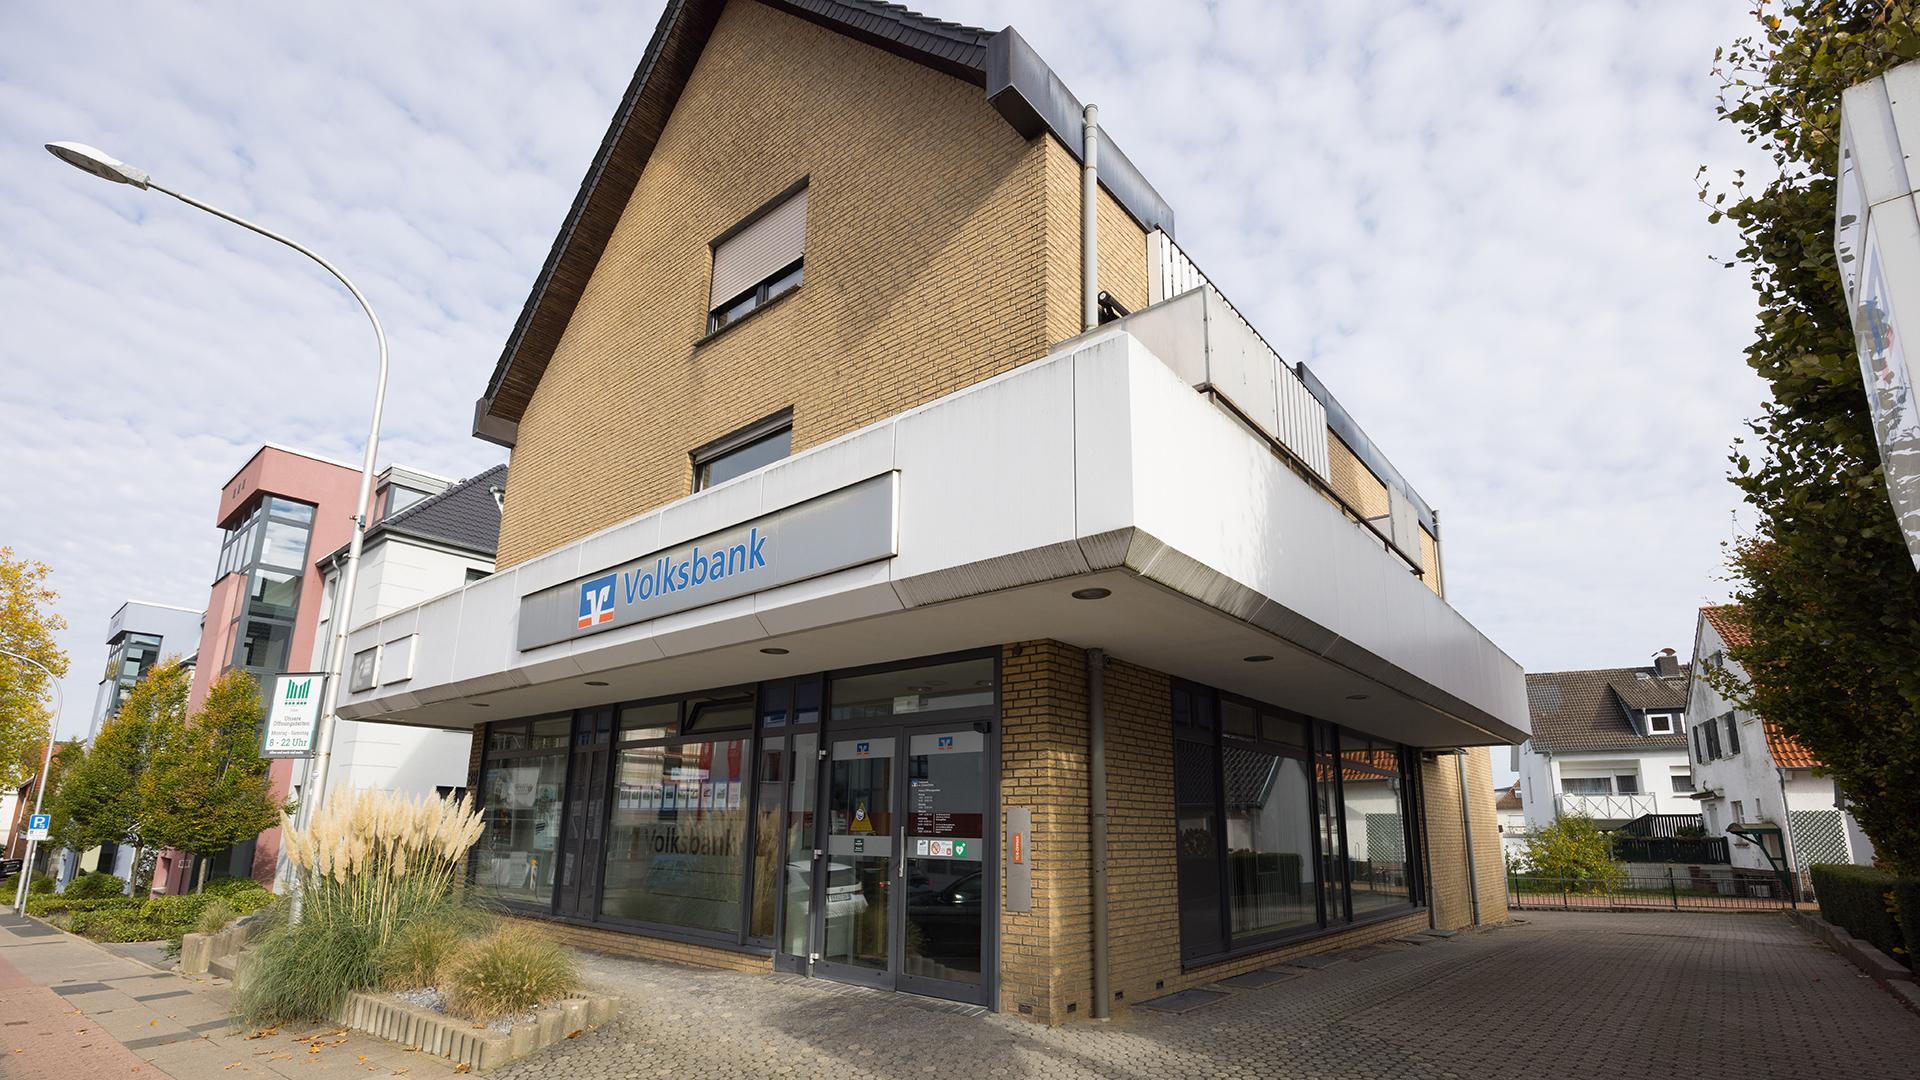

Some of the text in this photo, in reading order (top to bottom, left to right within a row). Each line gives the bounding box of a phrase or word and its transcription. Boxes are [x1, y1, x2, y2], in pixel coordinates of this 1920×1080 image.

[623, 527, 767, 605] Volksbank
[269, 738, 275, 747] 8
[281, 738, 291, 747] 22
[292, 738, 308, 747] Uhr
[33, 816, 46, 828] P
[644, 826, 738, 858] Volksbank
